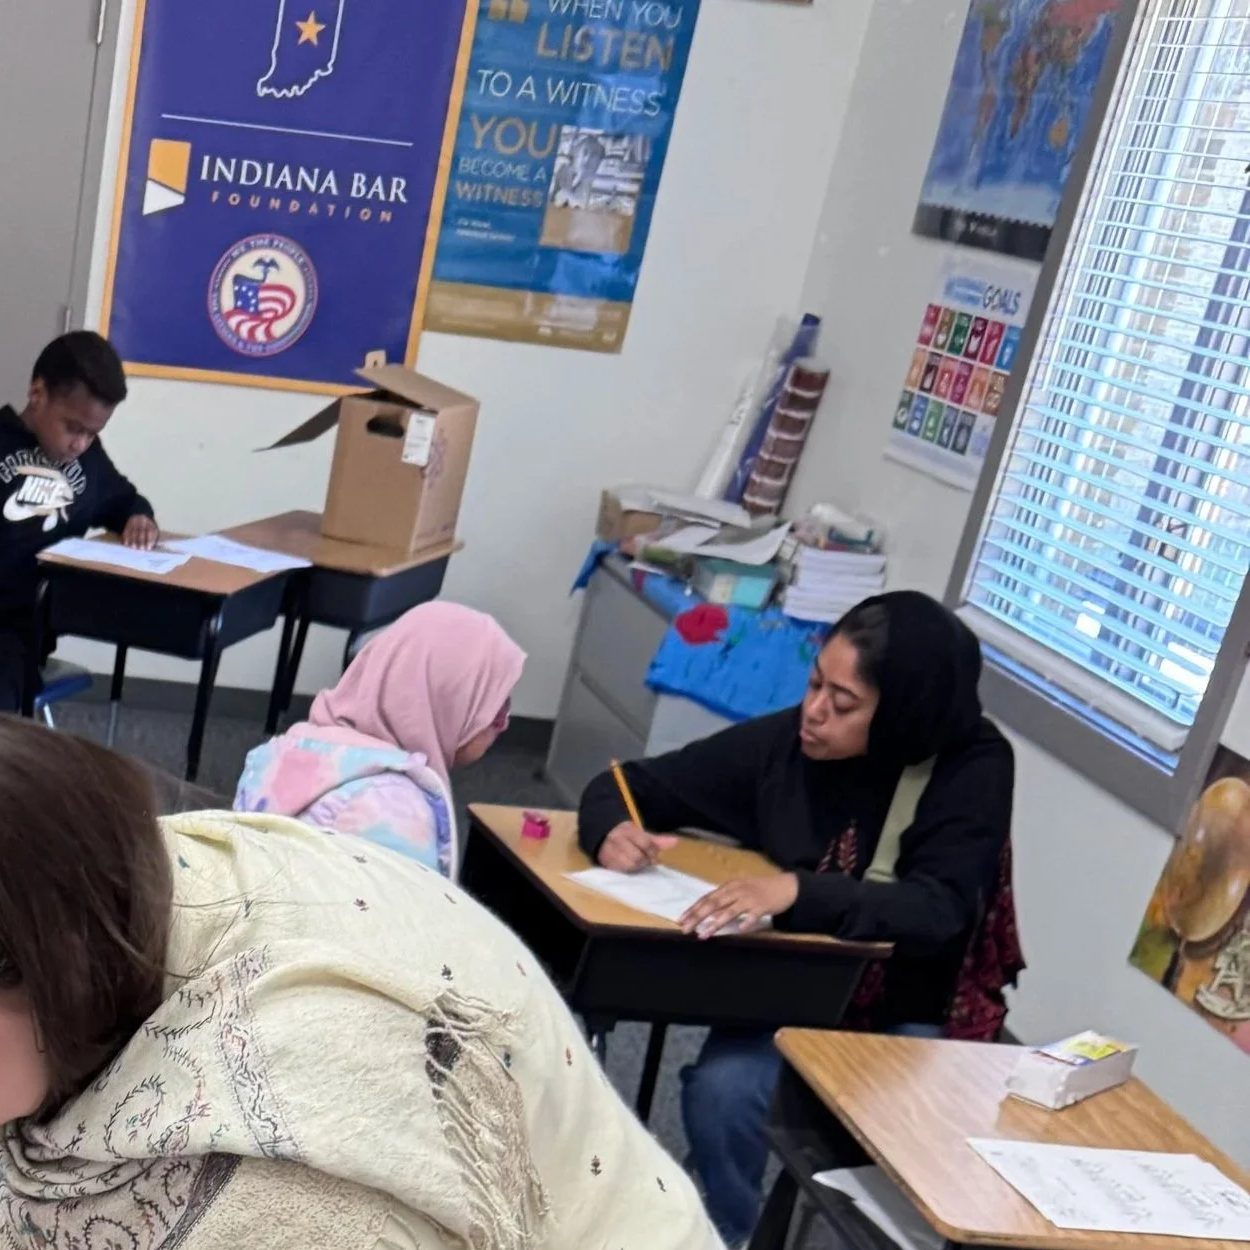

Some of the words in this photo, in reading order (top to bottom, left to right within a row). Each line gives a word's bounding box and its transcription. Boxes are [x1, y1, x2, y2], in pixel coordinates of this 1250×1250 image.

[551, 0, 623, 19] WHEN
[634, 4, 682, 29] YOU
[537, 23, 675, 71] LISTEN
[478, 69, 512, 97] TO
[516, 76, 536, 101] A
[547, 77, 667, 116] WITNESS
[471, 114, 558, 160] YOU
[200, 155, 339, 196] INDIANA
[350, 172, 409, 204] BAR
[458, 156, 529, 182] BECOME
[533, 166, 547, 183] A
[211, 190, 393, 223] FOUNDATION
[454, 180, 544, 208] WITNESS
[982, 285, 1022, 316] GOALS
